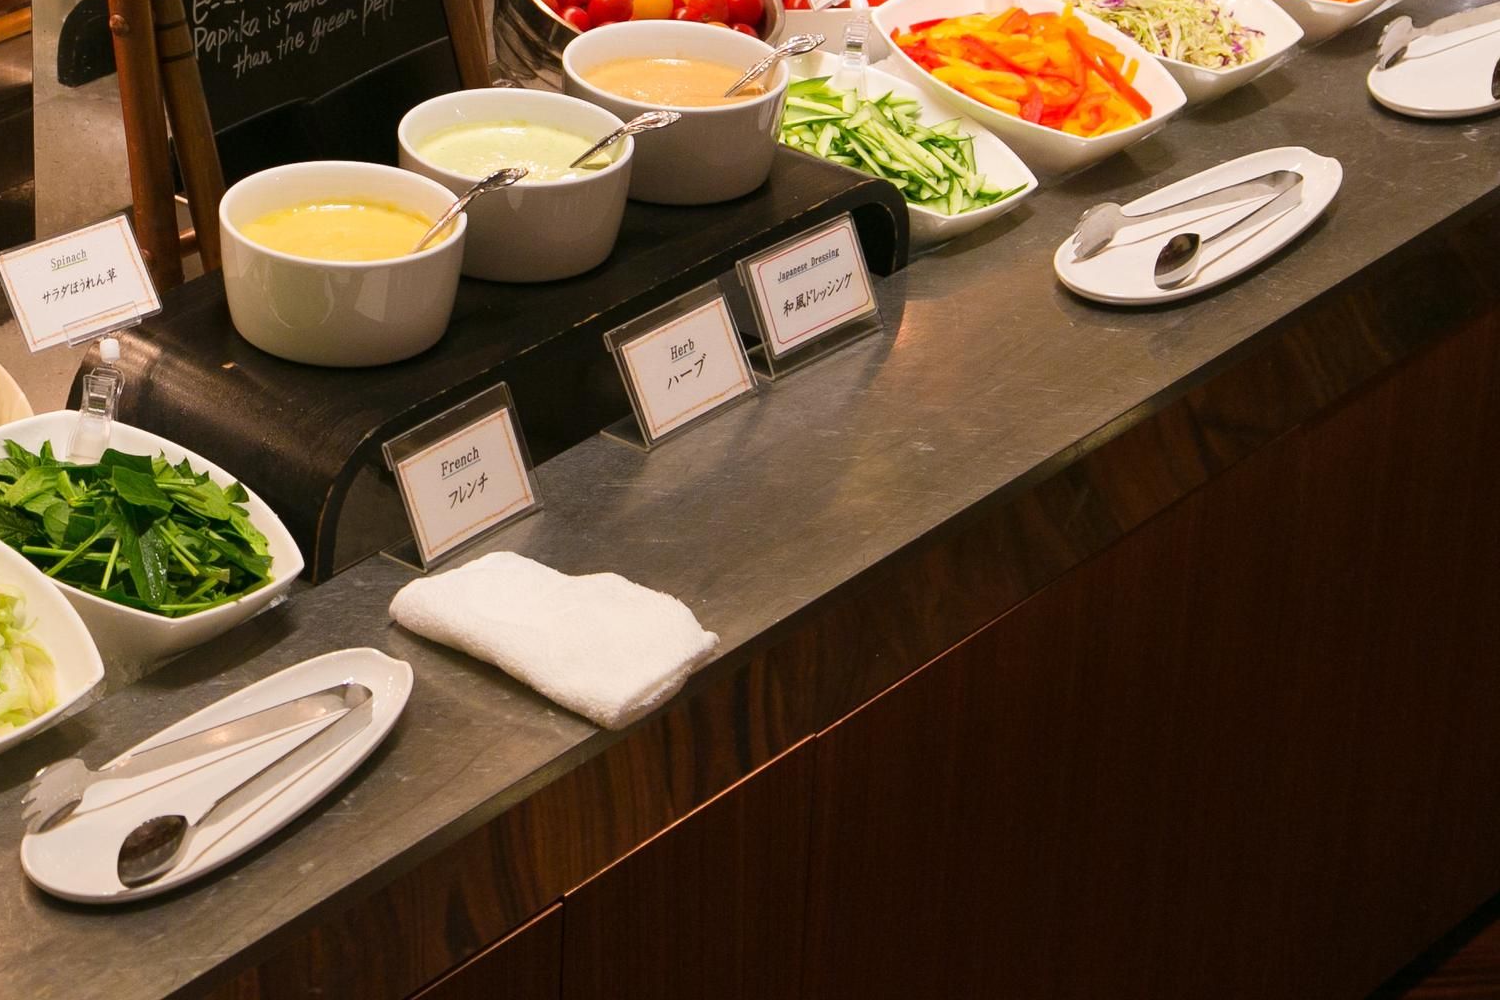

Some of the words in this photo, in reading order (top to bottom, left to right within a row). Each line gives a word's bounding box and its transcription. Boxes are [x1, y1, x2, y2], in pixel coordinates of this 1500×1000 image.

[193, 10, 262, 64] Paprika
[268, 8, 282, 31] is
[232, 48, 274, 80] than
[276, 23, 305, 61] the
[308, 6, 358, 55] green
[50, 248, 88, 269] Spinach
[777, 261, 808, 282] Japanese
[811, 247, 840, 267] Dressing
[42, 267, 117, 305] サラダほうれん草
[783, 270, 853, 318] 和風ドレッシング
[670, 337, 695, 361] Herb
[666, 352, 708, 391] ハーブ
[440, 446, 480, 478] French
[447, 471, 490, 510] フレンチ
